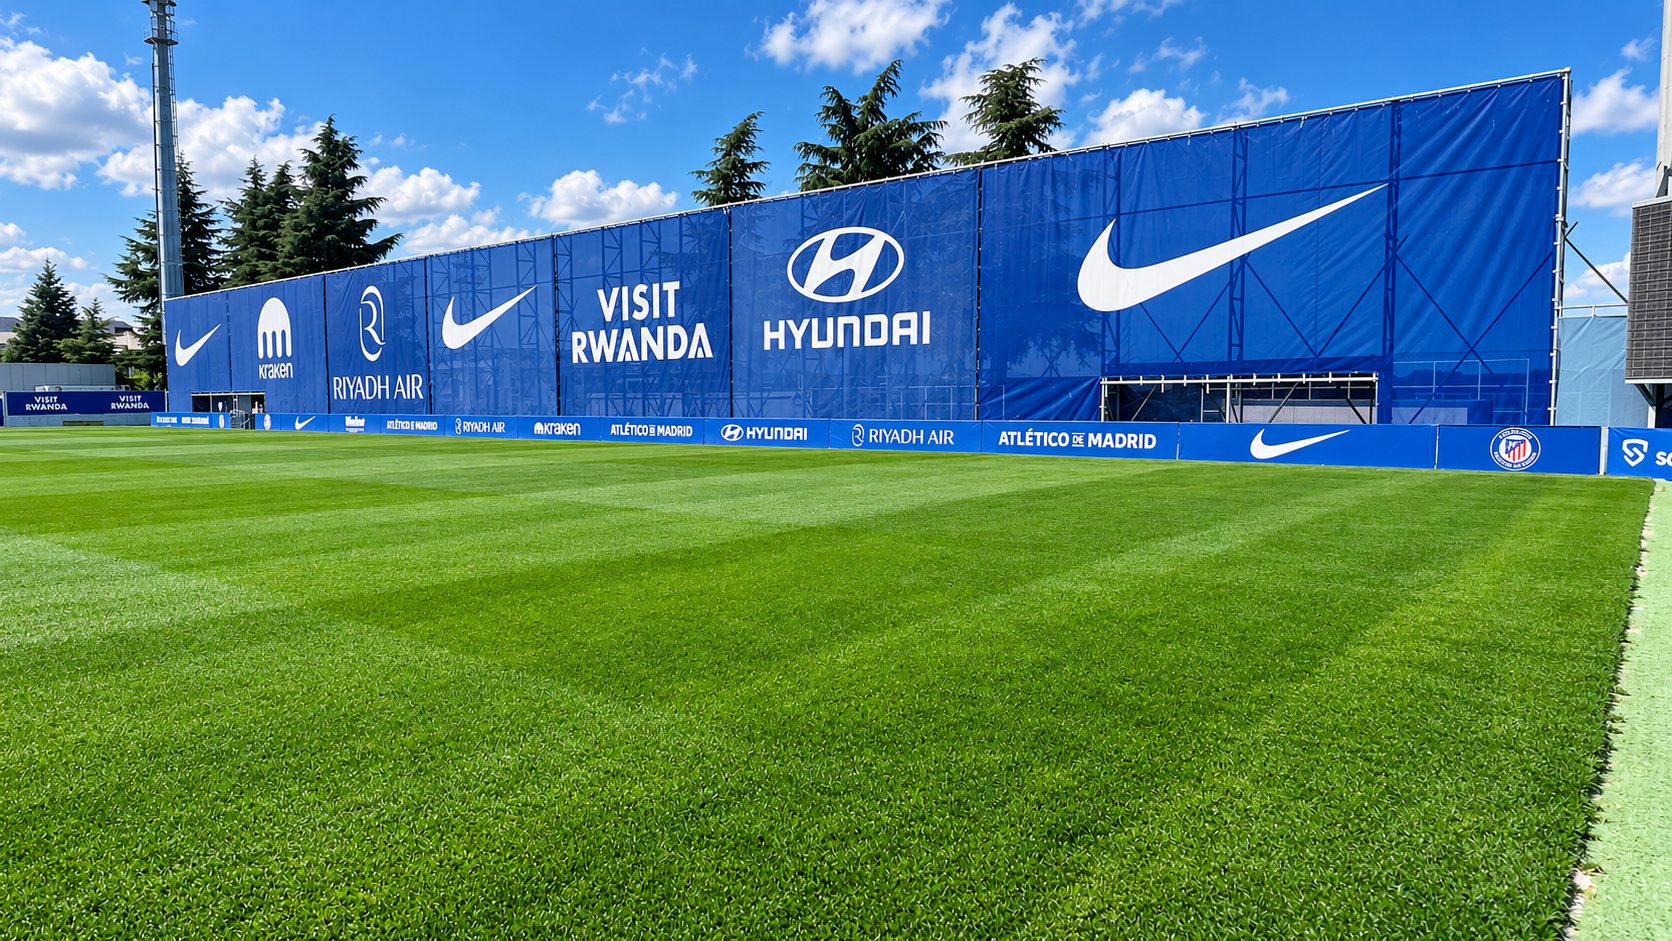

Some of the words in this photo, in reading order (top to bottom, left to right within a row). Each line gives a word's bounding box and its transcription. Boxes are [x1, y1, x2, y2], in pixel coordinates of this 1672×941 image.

[597, 281, 680, 322] VISIT
[763, 311, 931, 351] HYUNDAI
[571, 323, 713, 364] RWANDA
[333, 374, 390, 400] RIYADH
[394, 373, 424, 400] AIR
[25, 403, 68, 411] RWANDA
[110, 402, 150, 410] RWANDA
[463, 421, 491, 433] RIYADH
[491, 422, 506, 434] AIR
[610, 421, 649, 436] ATLÉTICO
[657, 425, 693, 437] MADRID
[746, 427, 808, 441] HYUNDAI
[869, 428, 925, 445] RIYADH
[927, 428, 955, 446] AIR
[998, 428, 1070, 448] ATLÉTICO
[1072, 434, 1085, 446] DE
[1087, 433, 1158, 450] MADRID
